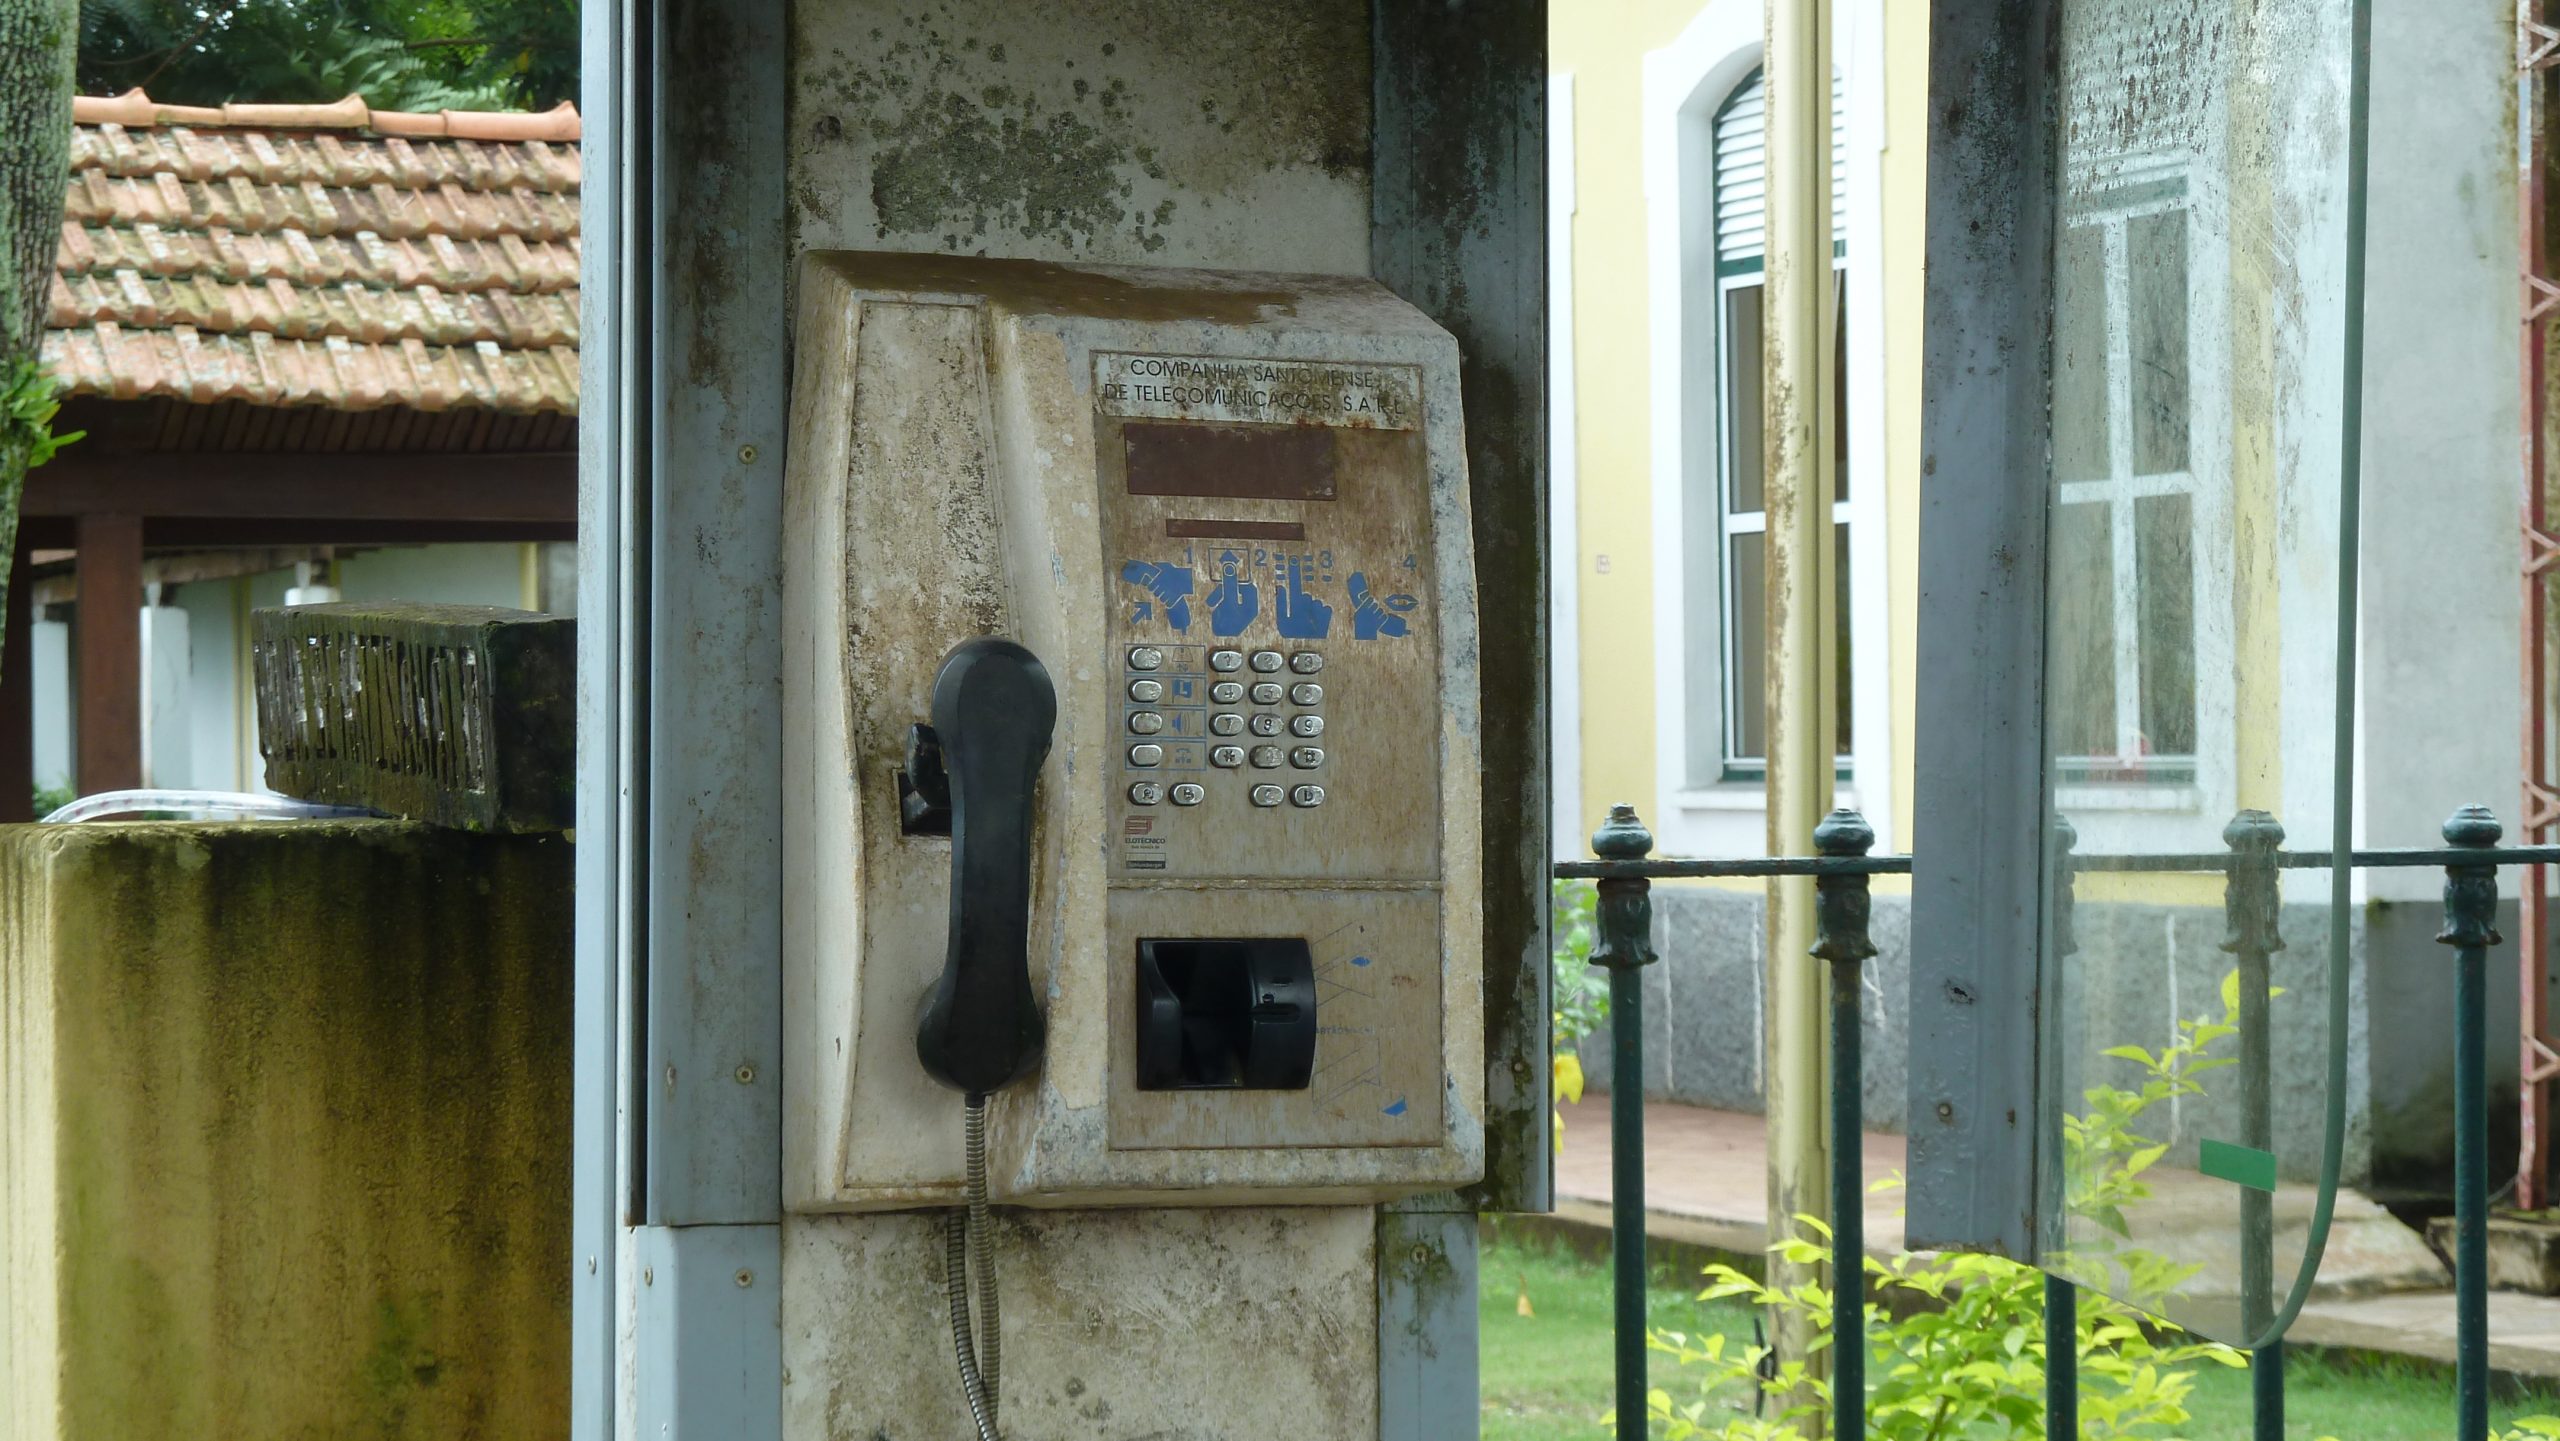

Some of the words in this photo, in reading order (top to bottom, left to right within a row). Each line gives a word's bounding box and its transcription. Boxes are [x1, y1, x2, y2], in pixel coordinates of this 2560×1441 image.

[1131, 359, 1248, 380] COMPANHIA
[1254, 365, 1374, 387] SANTOMENSE
[1104, 383, 1127, 400] DE
[1184, 546, 1193, 564] 1
[1255, 549, 1267, 566] 2
[1320, 550, 1333, 568] 3
[1403, 554, 1417, 571] 4
[1264, 654, 1274, 669] 2
[1264, 718, 1272, 731] 8
[1304, 719, 1313, 732] 9
[1183, 788, 1195, 801] B
[1304, 790, 1313, 802] D
